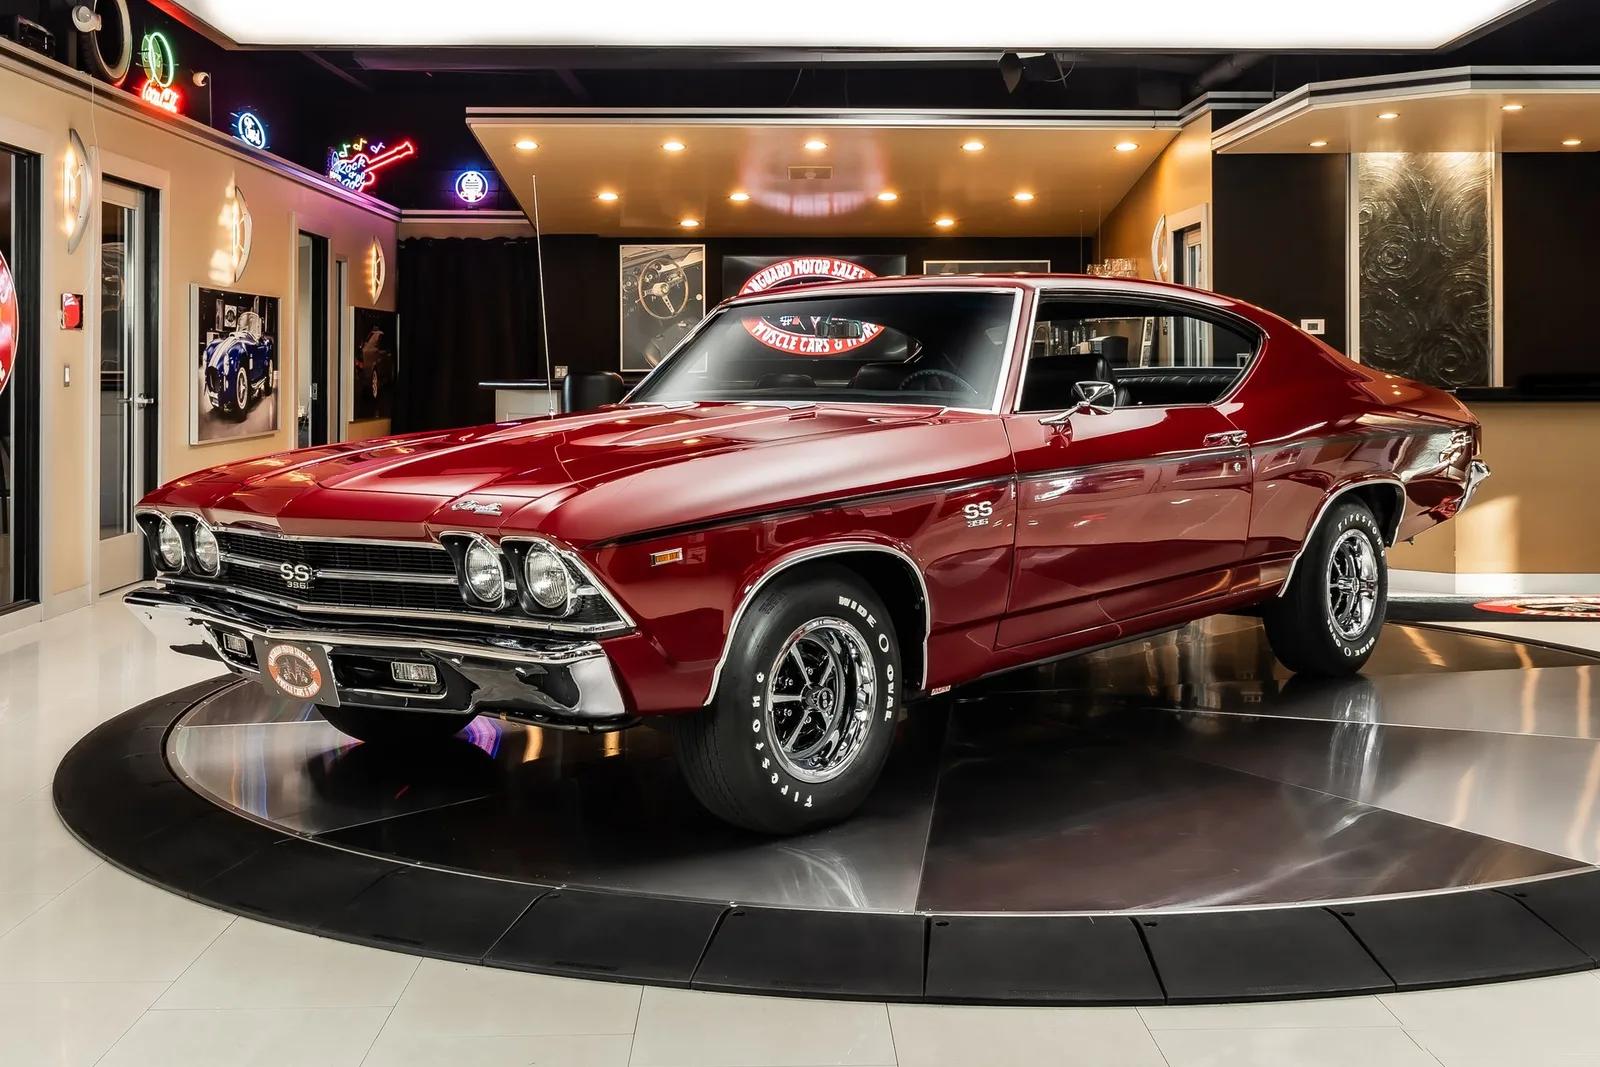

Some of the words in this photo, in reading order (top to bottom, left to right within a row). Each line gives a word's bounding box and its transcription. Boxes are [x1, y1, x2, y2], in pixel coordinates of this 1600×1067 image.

[339, 155, 366, 175] Rock
[744, 262, 792, 294] NGUARD
[792, 259, 831, 276] MOTOR
[751, 320, 798, 351] MUSCLE
[799, 336, 830, 353] CARS
[964, 500, 993, 519] SS
[280, 563, 309, 581] SS
[838, 595, 877, 629] WIDE
